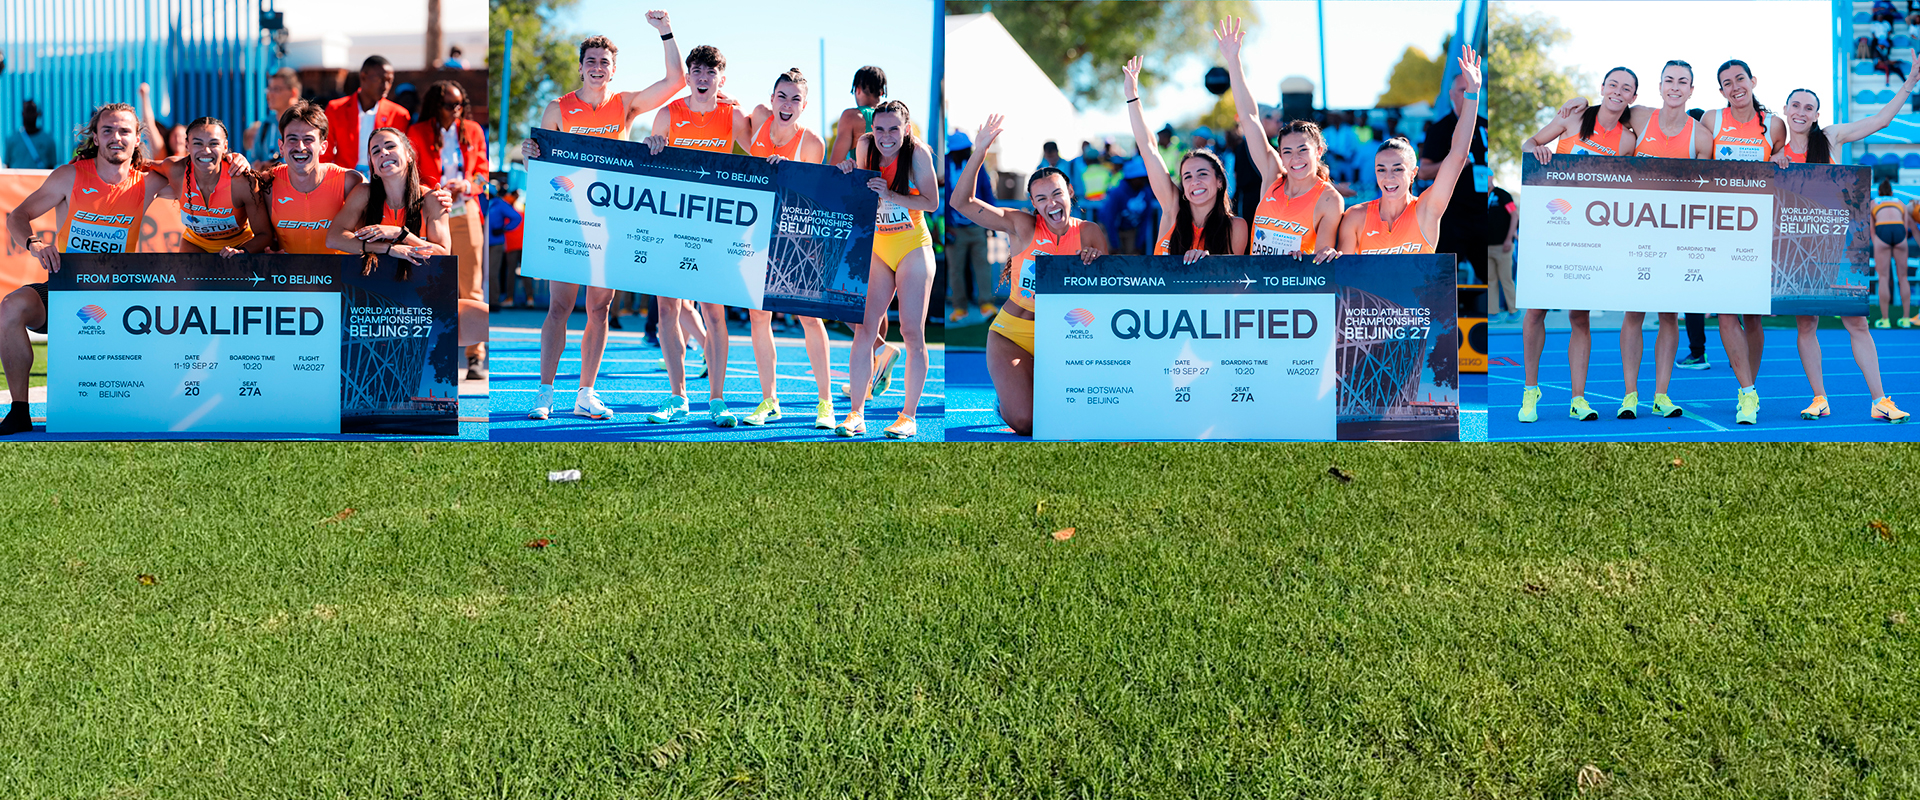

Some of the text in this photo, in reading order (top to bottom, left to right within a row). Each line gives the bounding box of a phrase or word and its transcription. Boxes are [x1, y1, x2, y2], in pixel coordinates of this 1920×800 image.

[569, 123, 620, 135] ESPAÑA
[673, 137, 728, 148] ESPAÑA
[1719, 135, 1763, 145] ESPAÑA
[551, 148, 770, 185] FROM BOTSWANA TO BEIJING
[1546, 171, 1767, 188] FROM BOTSWANA TO BEIJING
[586, 181, 758, 227] QUALIFIED
[781, 205, 854, 221] WORLD ATHLETICS
[1585, 200, 1759, 231] QUALIFIED
[1780, 207, 1850, 216] WORLD ATHLETICS
[73, 210, 135, 225] ESPAÑA
[780, 213, 853, 229] CHAMPIONSHIPS
[1780, 215, 1850, 224] CHAMPIONSHIPS
[572, 219, 602, 228] PASSENGER
[1253, 215, 1310, 236] ESPAÑA
[70, 225, 116, 240] DEBSWANA
[779, 221, 852, 240] BEIJING 27
[1780, 223, 1850, 235] BEIJING 27
[626, 233, 642, 241] 11-19
[641, 235, 655, 243] SEP
[673, 233, 700, 242] BOARDING
[71, 236, 123, 253] CRESPI
[564, 239, 603, 251] BOTSWANA
[684, 241, 702, 250] 10:20
[732, 241, 751, 249] FLIGHT
[1361, 242, 1423, 255] ESPAÑA
[563, 247, 590, 258] BEIJING
[726, 248, 755, 258] WA2027
[1658, 251, 1668, 259] 27
[1687, 252, 1705, 260] 10:20
[633, 255, 648, 264] 20
[1730, 254, 1758, 262] WA2027
[679, 261, 699, 272] 27A
[1563, 264, 1603, 272] BOTSWANA
[76, 274, 333, 285] FROM BOTSWANA TO BEIJING
[1563, 272, 1591, 280] BEIJING
[1637, 272, 1651, 281] 20
[1684, 273, 1704, 282] 27A
[1063, 276, 1326, 287] FROM BOTSWANA TO BEIJING
[350, 307, 433, 315] WORLD ATHLETICS
[1344, 307, 1431, 316] WORLD ATHLETICS
[122, 305, 324, 335] QUALIFIED
[350, 315, 433, 324] CHAMPIONSHIPS
[1110, 308, 1318, 340] QUALIFIED
[1344, 316, 1431, 326] CHAMPIONSHIPS
[349, 325, 433, 338] BEIJING 27
[1344, 326, 1431, 340] BEIJING 27
[173, 362, 219, 370] 11-19 SEP 27
[242, 362, 263, 370] 10:20
[292, 363, 325, 371] WA2027
[1163, 367, 1210, 375] 11-19 SEP 27
[1234, 367, 1255, 375] 10:20
[1286, 367, 1320, 376] WA2027
[99, 380, 145, 388] BOTSWANA
[99, 390, 131, 398] BEIJING
[184, 387, 200, 396] 20
[238, 387, 262, 396] 27A
[1087, 386, 1134, 394] BOTSWANA
[1087, 396, 1120, 405] BEIJING
[1174, 392, 1191, 402] 20
[1231, 392, 1255, 402] 27A
